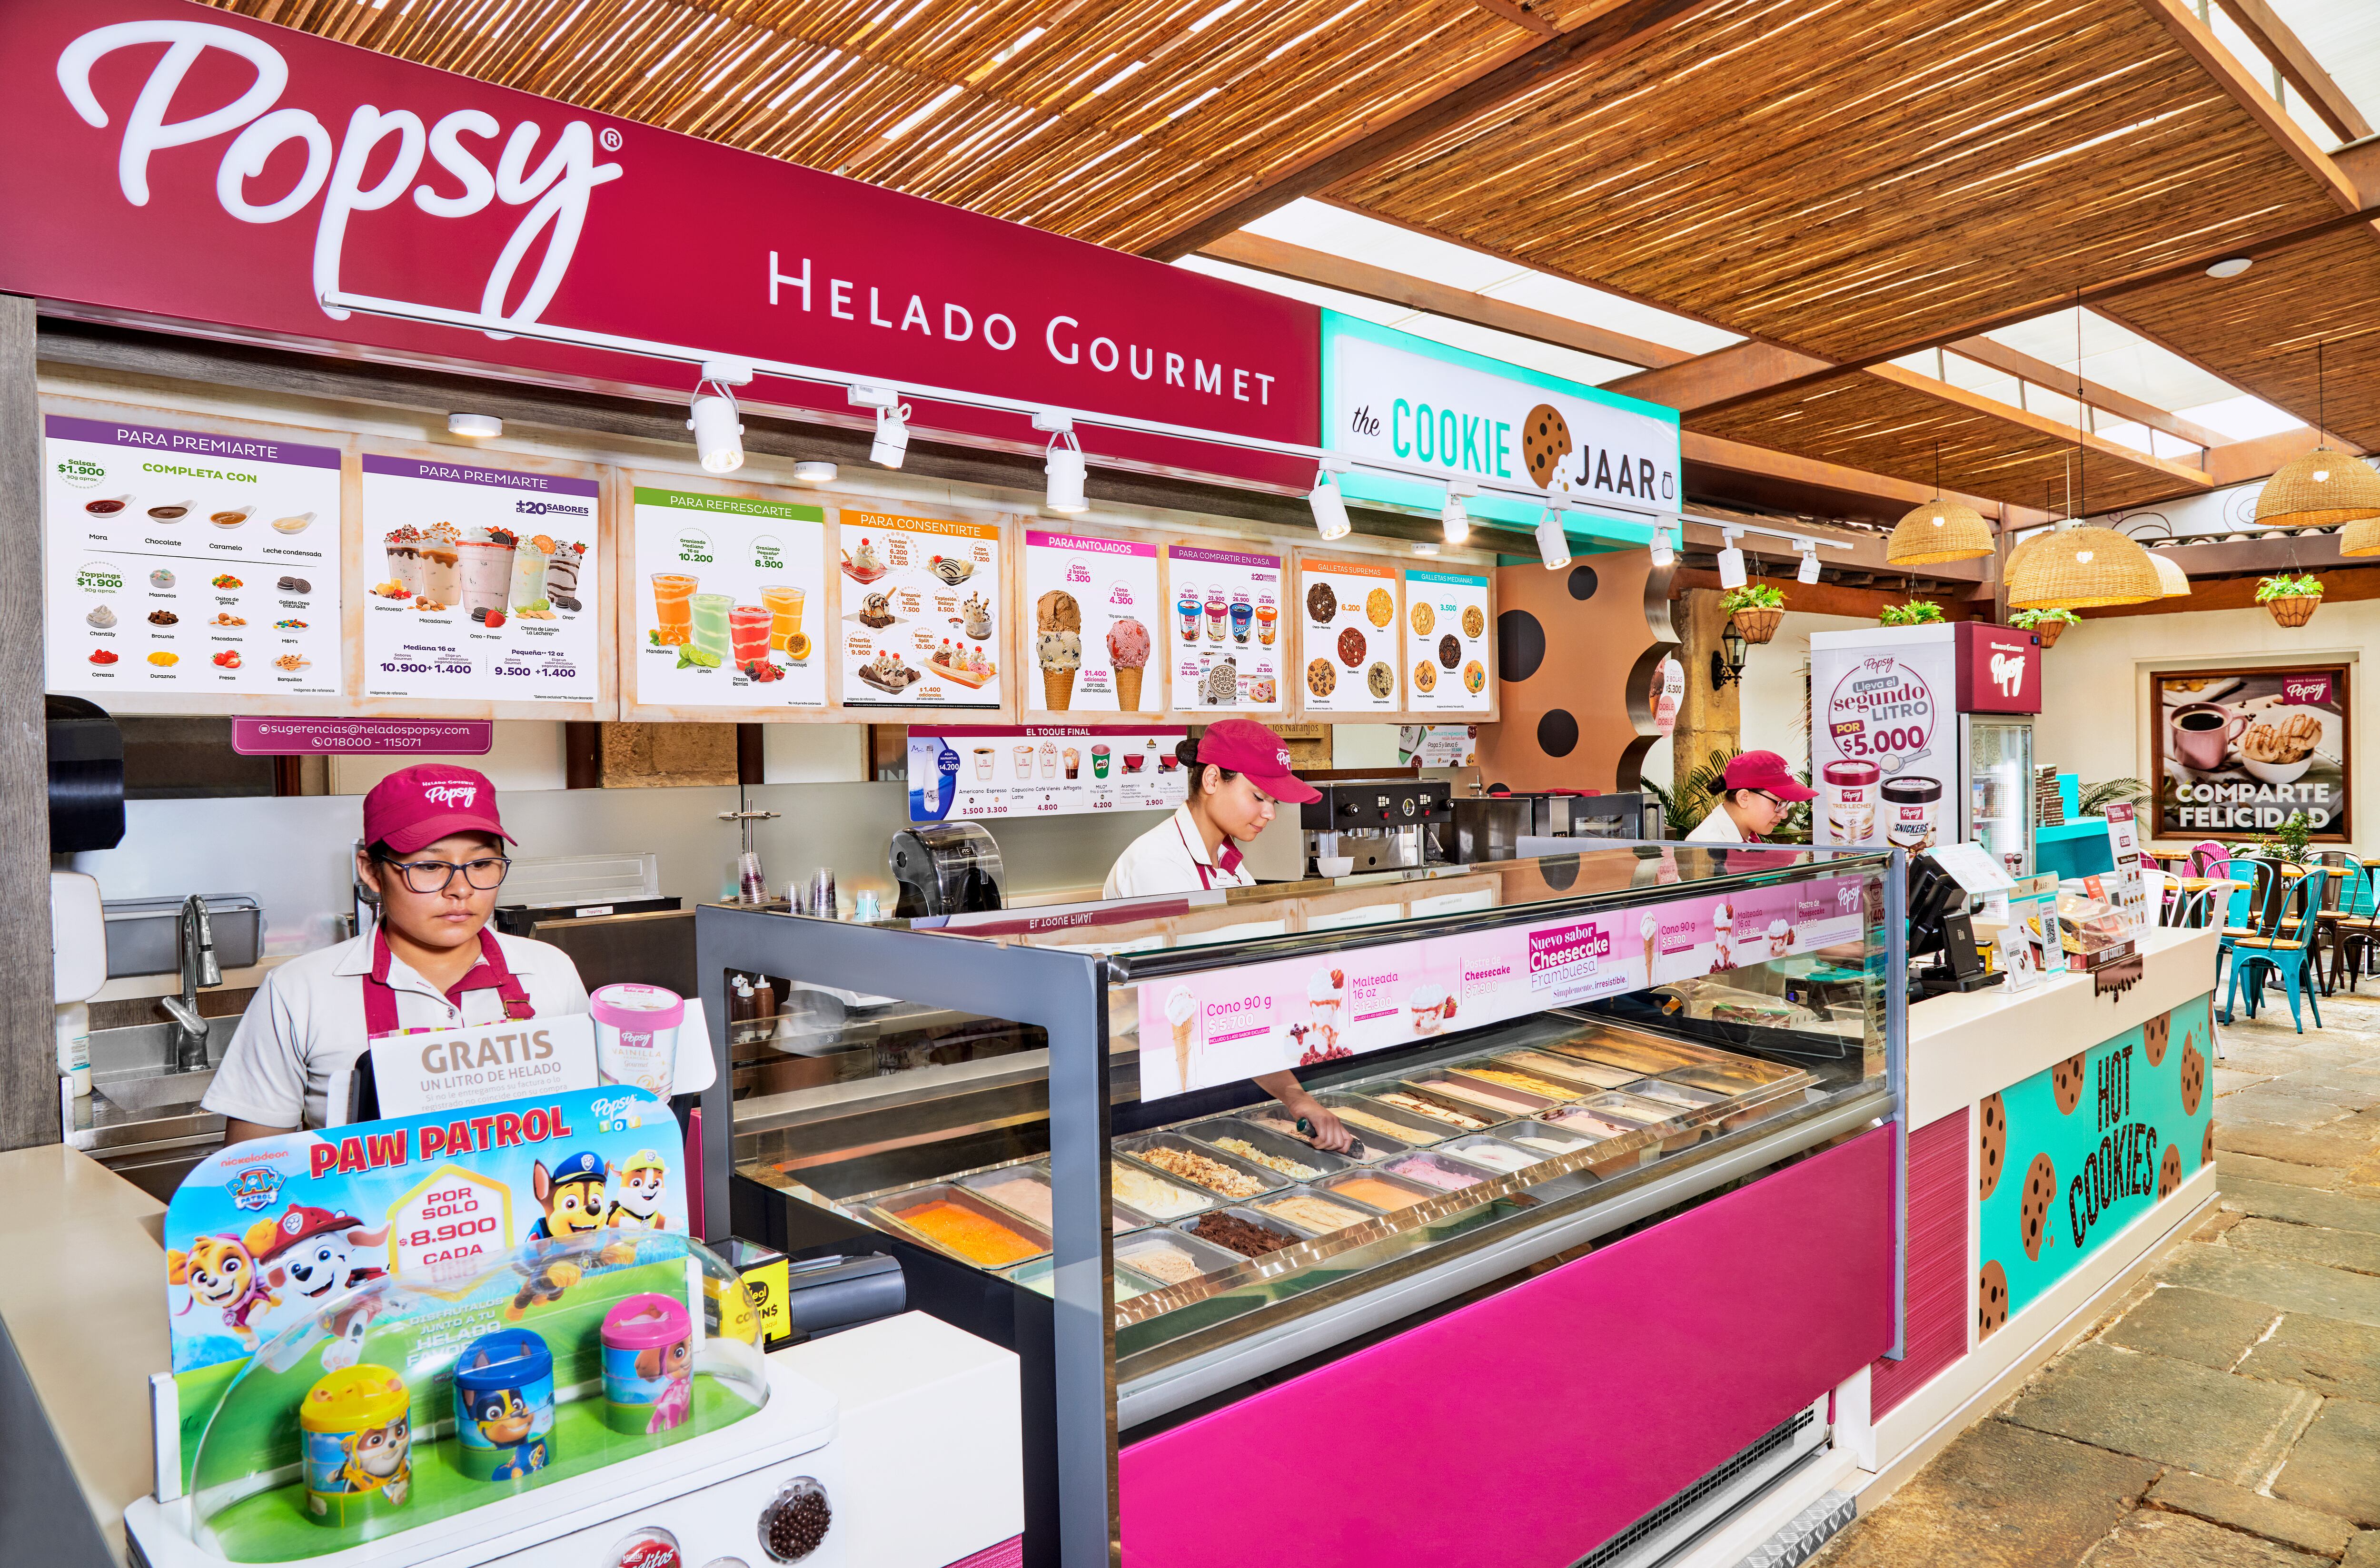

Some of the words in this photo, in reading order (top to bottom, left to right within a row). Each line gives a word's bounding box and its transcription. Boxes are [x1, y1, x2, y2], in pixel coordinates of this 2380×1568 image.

[57, 20, 624, 340] Popsy
[769, 251, 1016, 351] HELADO
[1047, 316, 1275, 405] GOURMET
[117, 429, 168, 446] PARA
[173, 435, 278, 459] PREMIARTE
[1352, 404, 1380, 437] the
[1393, 398, 1511, 479] COOKIE
[1575, 445, 1656, 501] JAAR
[58, 463, 105, 477] $1.900
[68, 459, 96, 467] Salsas
[142, 463, 223, 480] COMPLETA
[227, 472, 257, 483] CON
[419, 465, 460, 480] PARA
[464, 470, 548, 489] PREMIARTE
[670, 496, 704, 508] PARA
[707, 499, 792, 517] REFRESCARTE
[861, 514, 894, 527] PARA
[897, 519, 981, 536] CONSENTIRTE
[145, 538, 181, 546] Chocolate
[209, 543, 242, 551] Caramelo
[1049, 536, 1074, 548] PARA
[1076, 539, 1131, 554] ANTOJADOS
[679, 553, 713, 563] 10.200
[755, 559, 783, 569] 8.900
[1179, 550, 1198, 558] PARA
[1200, 552, 1240, 562] COMPARTIR
[80, 571, 120, 580] Toppings
[1067, 574, 1091, 583] 5.300
[1318, 564, 1348, 572] GALLETAS
[1349, 567, 1381, 575] SUPREMAS
[1421, 573, 1447, 582] GALLETAS
[77, 577, 123, 588] $1.900
[1109, 596, 1133, 605] 4.300
[380, 662, 426, 673] 10.900
[495, 667, 531, 676] 9.500
[1864, 657, 1895, 674] Popsy
[1855, 681, 1884, 692] Lleva
[2287, 683, 2327, 701] Popsy
[1834, 683, 1925, 713] segundo
[1872, 701, 1928, 722] LITRO
[271, 724, 469, 736] sugerencias@heladospopsy.com
[1026, 728, 1036, 736] EL
[1286, 724, 1319, 735] Naranjos
[1836, 722, 1860, 734] POR
[324, 737, 371, 747] 018000
[384, 738, 421, 747] 115071
[425, 786, 476, 808] Popsy
[2175, 783, 2330, 803] COMPARTE
[2179, 807, 2330, 828] FELICIDAD
[1894, 823, 1929, 834] SNICKERS
[1837, 885, 1861, 913] Popsy
[1737, 908, 1763, 919] Malteada
[1661, 925, 1679, 935] Cono
[1530, 933, 1563, 953] Nuevo
[1564, 926, 1593, 944] sabor
[1530, 936, 1608, 972] Cheesecake
[1353, 971, 1398, 989] Malteada
[1465, 965, 1510, 981] Cheesecake
[1531, 959, 1596, 988] Frambuesa
[1353, 989, 1363, 999] 16
[1366, 988, 1376, 997] oz
[1207, 1001, 1240, 1016] Cono
[1245, 996, 1260, 1010] 90
[1264, 995, 1271, 1009] g
[621, 1032, 651, 1047] Popsy
[421, 1029, 554, 1075] GRATIS
[612, 1047, 661, 1057] VAINILLA
[420, 1079, 442, 1092] UN
[444, 1071, 485, 1089] LITRO
[487, 1070, 506, 1082] DE
[509, 1062, 561, 1079] HELADO
[2098, 1044, 2133, 1134] HOT
[591, 1093, 638, 1120] Popsy
[309, 1128, 407, 1180] PAW
[418, 1104, 573, 1162] PATROL
[220, 1150, 289, 1168] nickelodeon
[225, 1171, 287, 1199] PAW
[2069, 1123, 2157, 1249] COOKIES
[240, 1193, 273, 1204] PATROL
[427, 1187, 472, 1205] POR
[422, 1200, 479, 1220] SOLO
[423, 1243, 484, 1266] CADA
[410, 1297, 504, 1326] DISFRUTALOS
[421, 1318, 462, 1335] JUNTO
[479, 1310, 496, 1320] TU
[416, 1321, 502, 1351] HELADO
